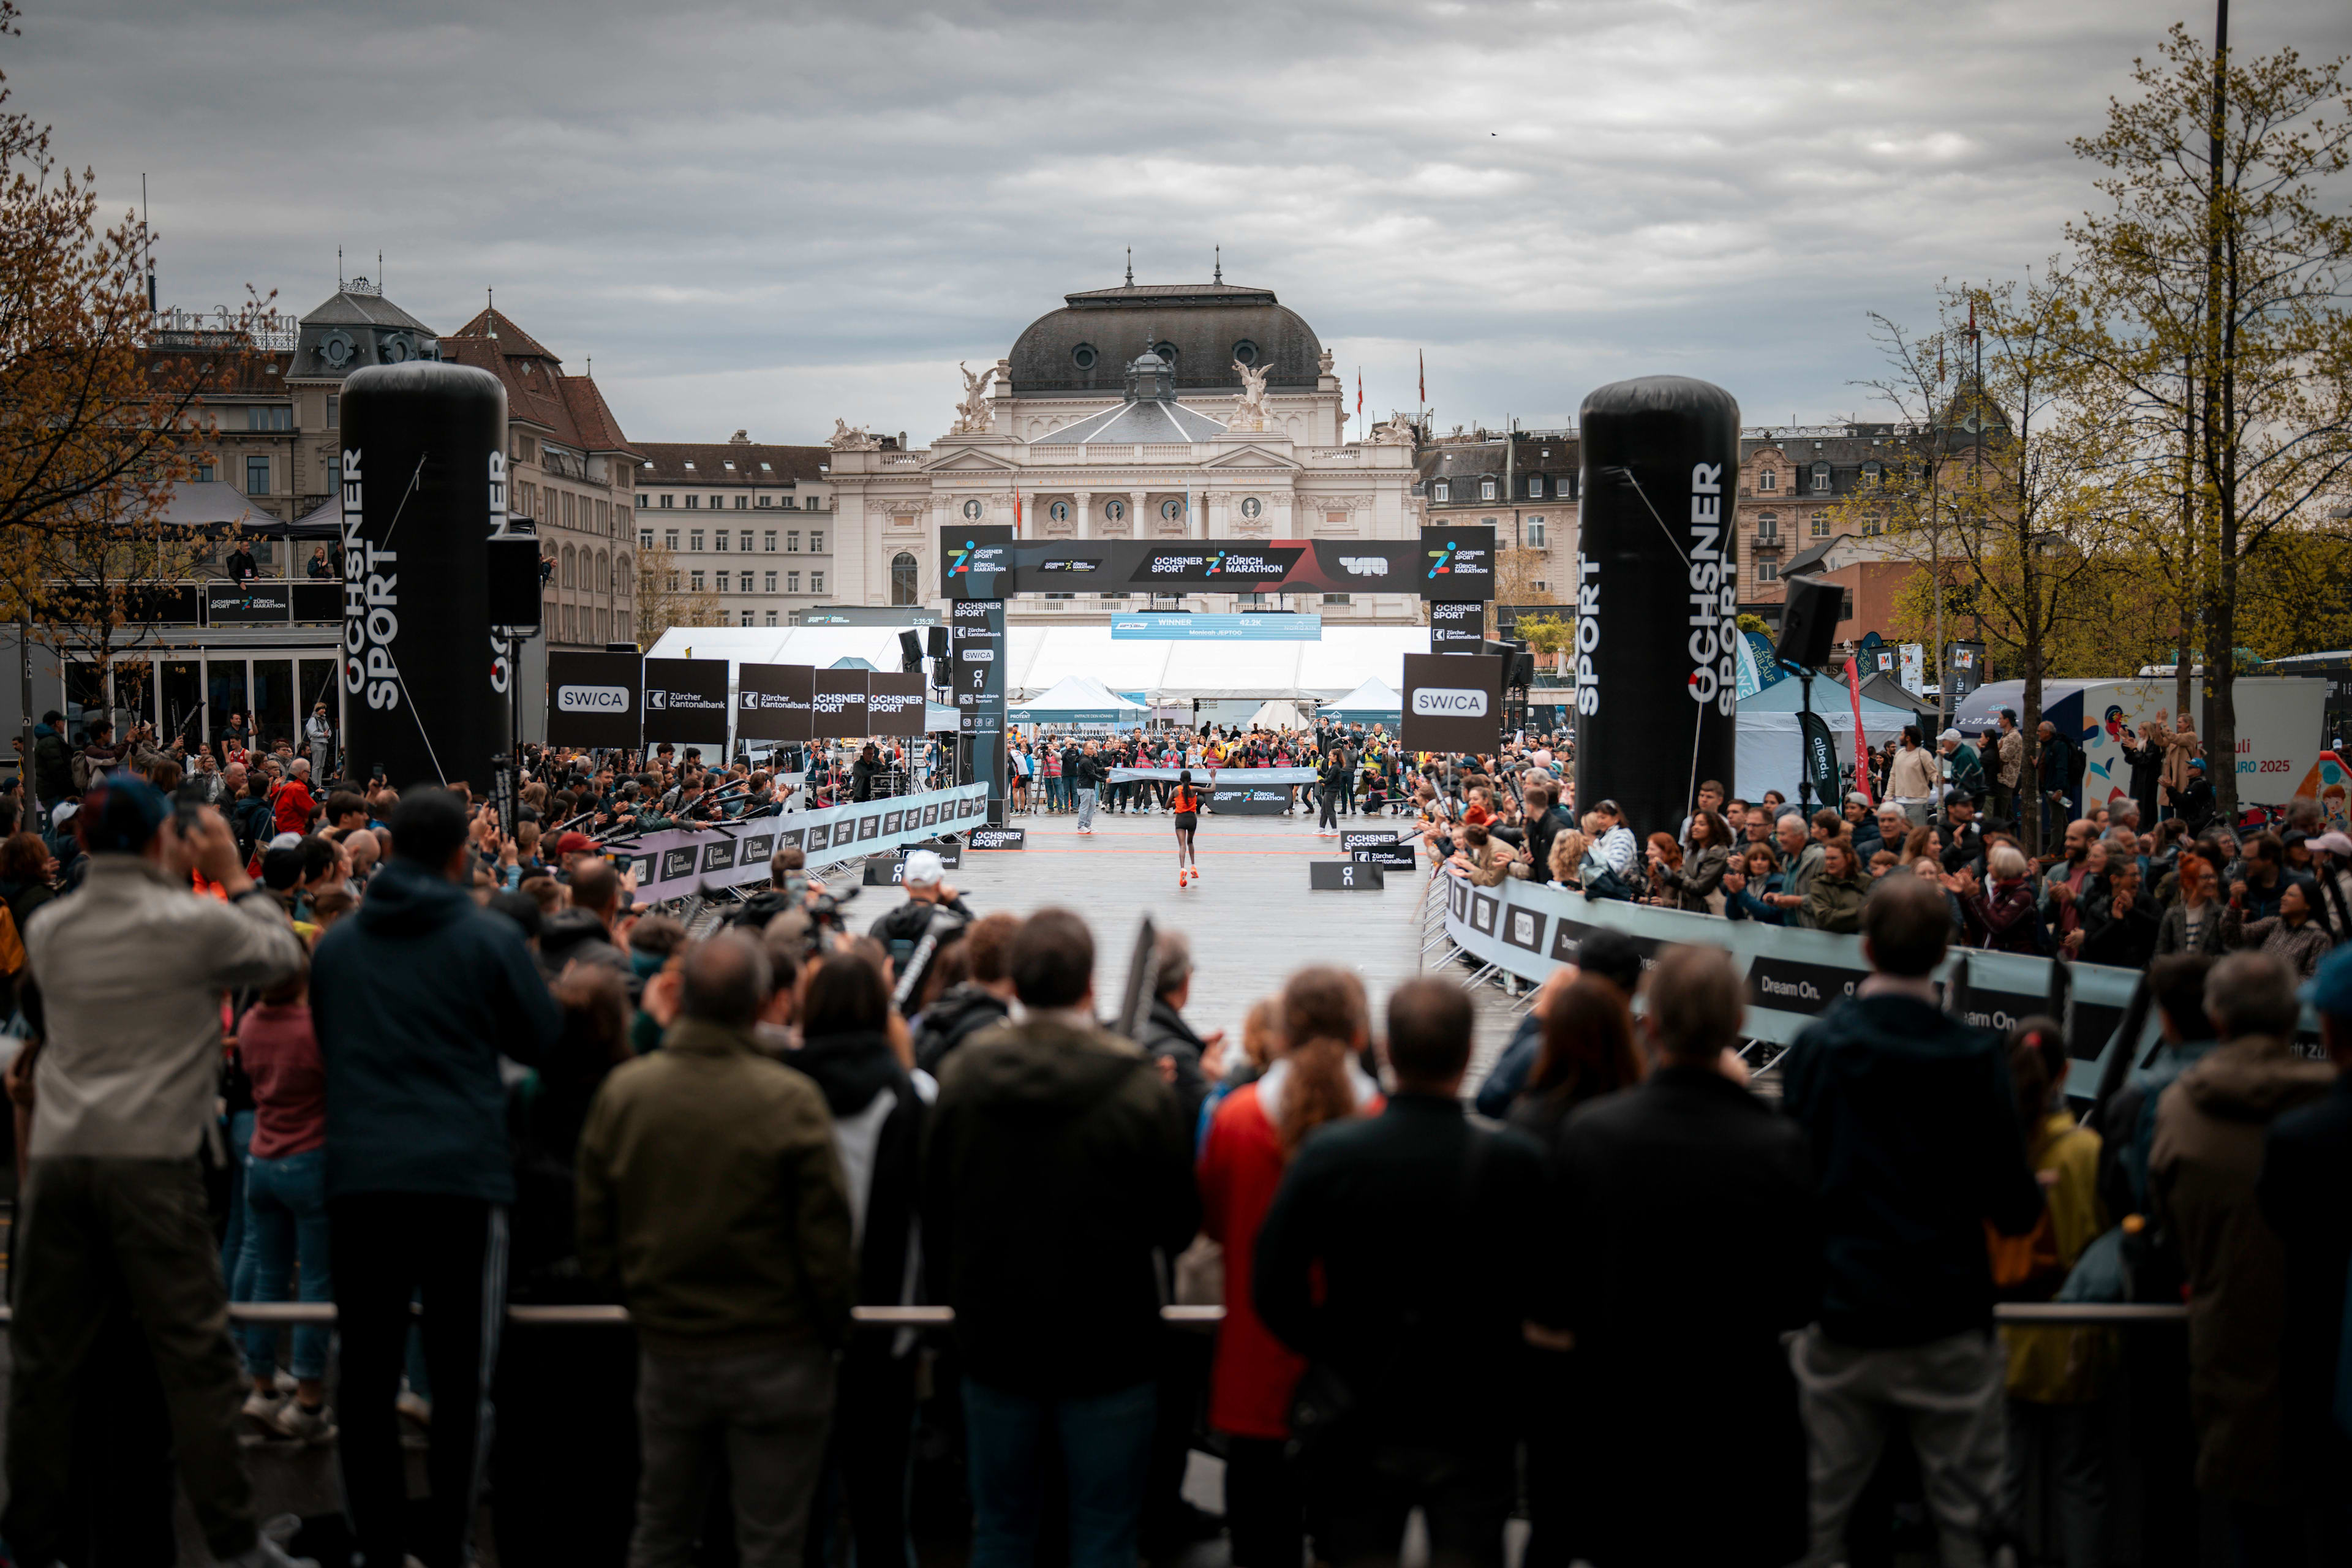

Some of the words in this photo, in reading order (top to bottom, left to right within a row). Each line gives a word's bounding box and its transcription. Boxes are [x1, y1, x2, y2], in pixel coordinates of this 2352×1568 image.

[1155, 557, 1202, 565] OCHSNER
[1226, 555, 1263, 565] ZÜRICH
[342, 448, 365, 695] OCHSNER
[1688, 462, 1721, 703] OCHSNER
[366, 540, 399, 710] SPORT
[1578, 552, 1600, 717] SPORT
[1718, 552, 1737, 717] SPORT
[1762, 647, 1777, 668] ZKB
[1858, 648, 1868, 668] ZKB
[564, 692, 623, 706] SWICA
[670, 692, 701, 701] Zürcher
[870, 695, 923, 704] OCHSNER
[1419, 695, 1480, 710] SWICA
[669, 700, 725, 709] Kantonalbank
[761, 701, 810, 709] Kantonalbank
[813, 704, 844, 713] PORT
[869, 704, 903, 713] SPORT
[2234, 739, 2250, 753] uli
[2260, 760, 2290, 773] 2025
[976, 831, 1021, 840] OCHSNER
[1762, 975, 1798, 997] Dream
[1799, 982, 1820, 1000] On.
